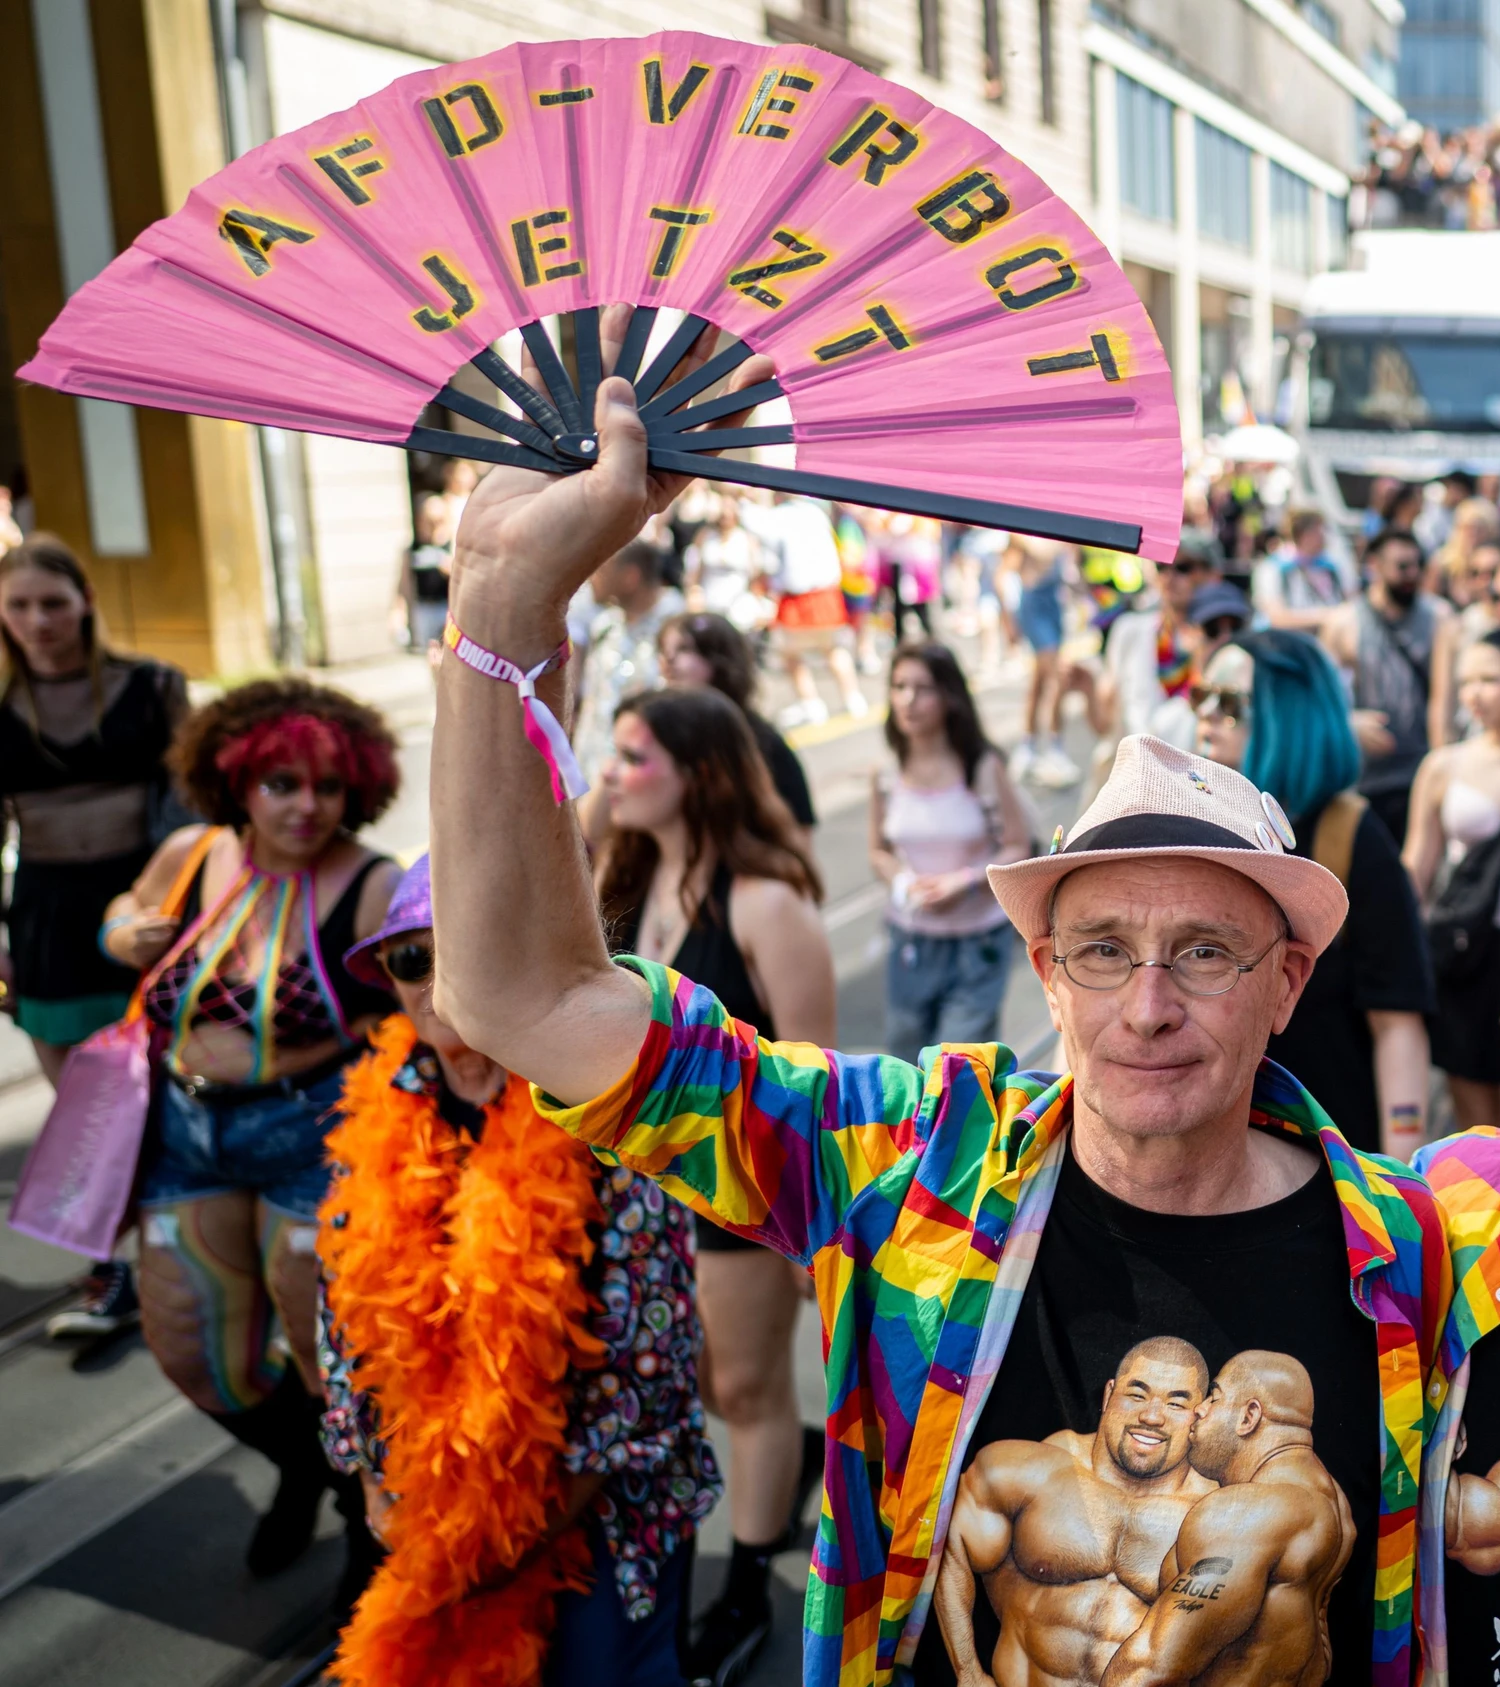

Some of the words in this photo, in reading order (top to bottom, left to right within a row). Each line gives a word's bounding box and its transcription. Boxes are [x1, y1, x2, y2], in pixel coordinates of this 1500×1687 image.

[218, 60, 1121, 382] AFD-VERBOT
[412, 207, 910, 362] JETZT
[1171, 1578, 1226, 1600] EAGLE
